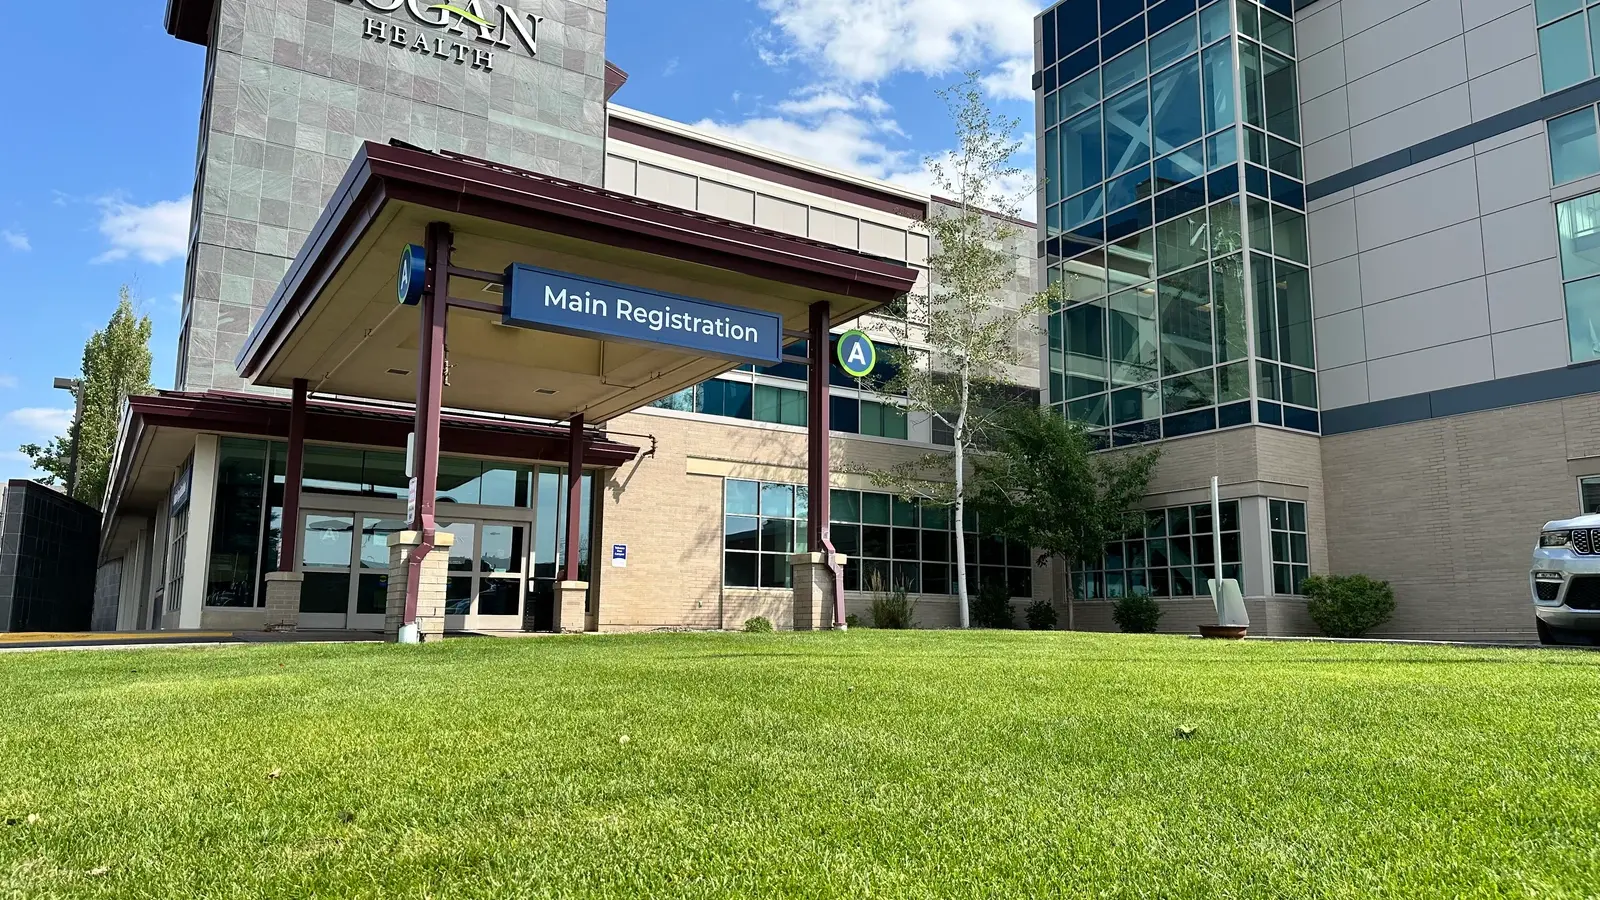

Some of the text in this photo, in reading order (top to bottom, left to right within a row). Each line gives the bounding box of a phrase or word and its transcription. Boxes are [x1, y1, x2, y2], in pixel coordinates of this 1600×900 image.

[362, 17, 495, 71] HEALTH
[400, 258, 408, 290] A
[544, 285, 758, 343] Main Registration
[847, 341, 867, 366] A
